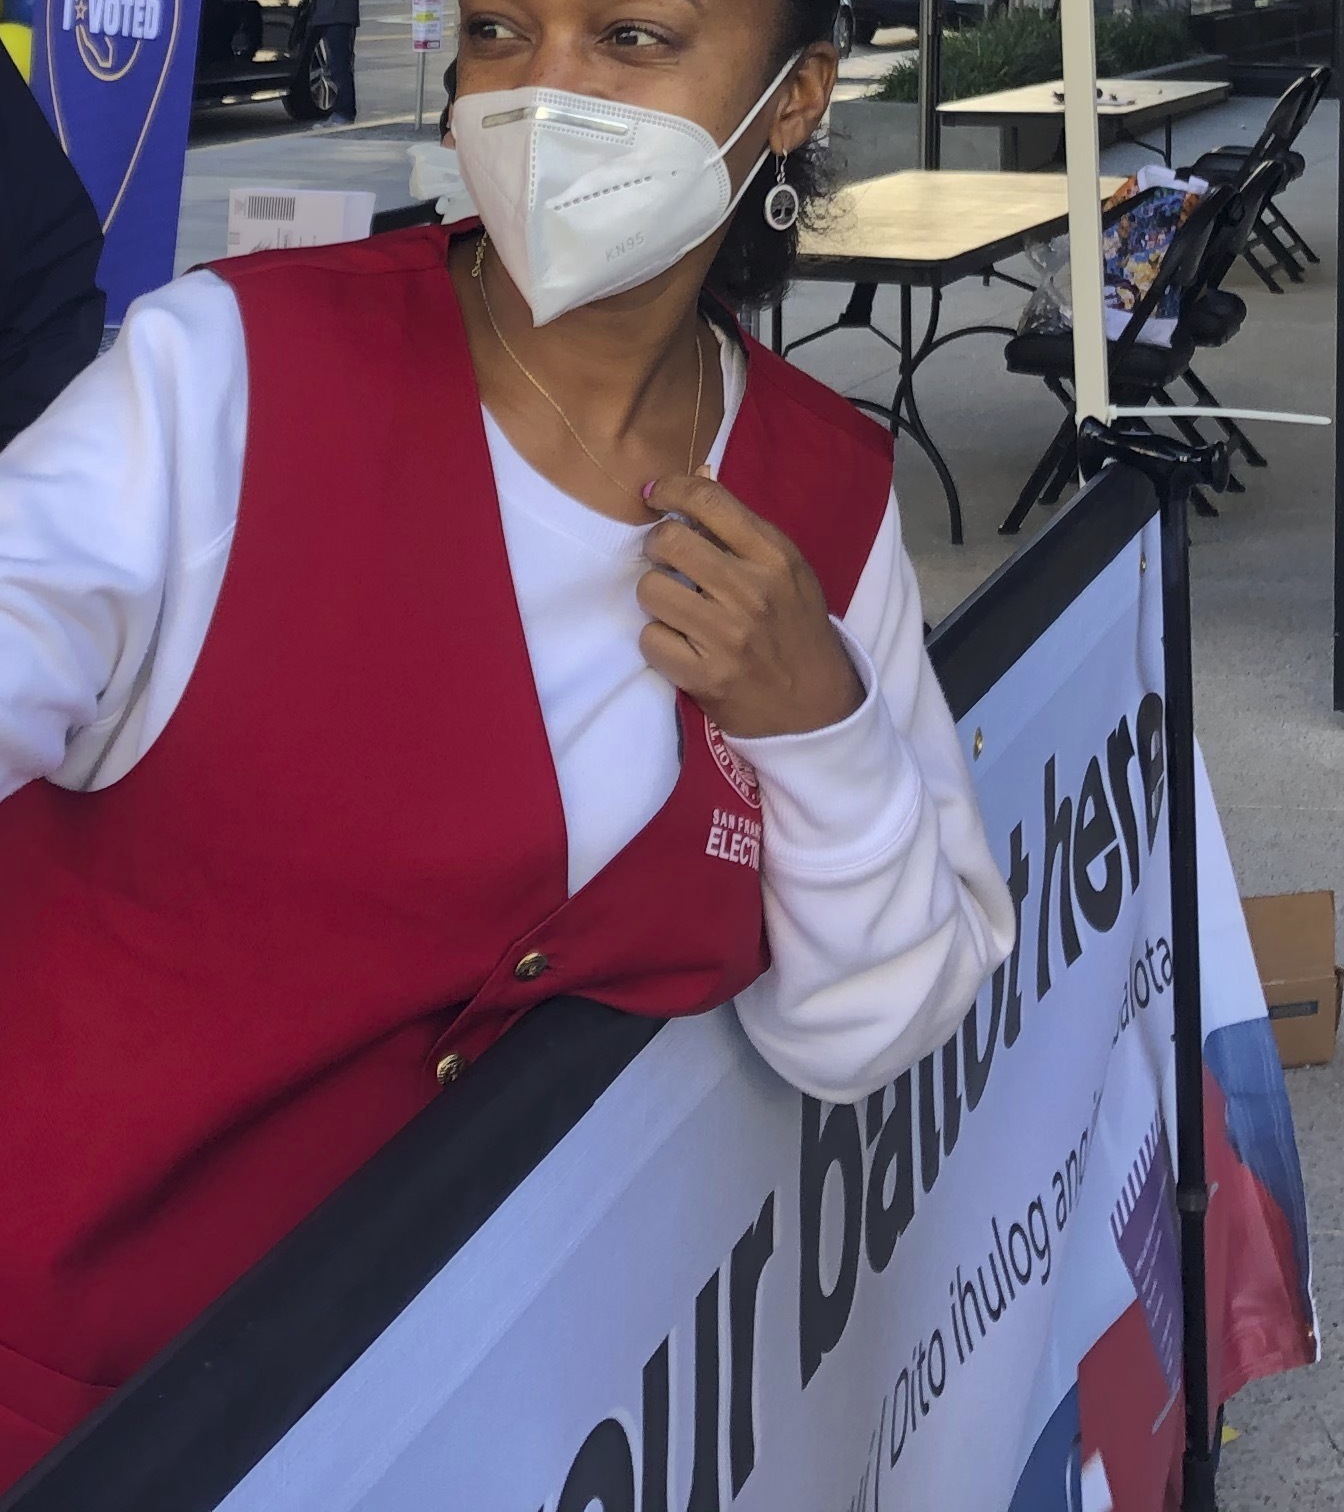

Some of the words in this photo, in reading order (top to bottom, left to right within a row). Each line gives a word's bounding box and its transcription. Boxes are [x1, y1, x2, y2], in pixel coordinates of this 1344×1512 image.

[605, 231, 645, 263] KN95
[712, 808, 736, 831] SAN
[1037, 691, 1165, 1004] here
[890, 1328, 947, 1469] Dito
[949, 1193, 1053, 1365] ihulog
